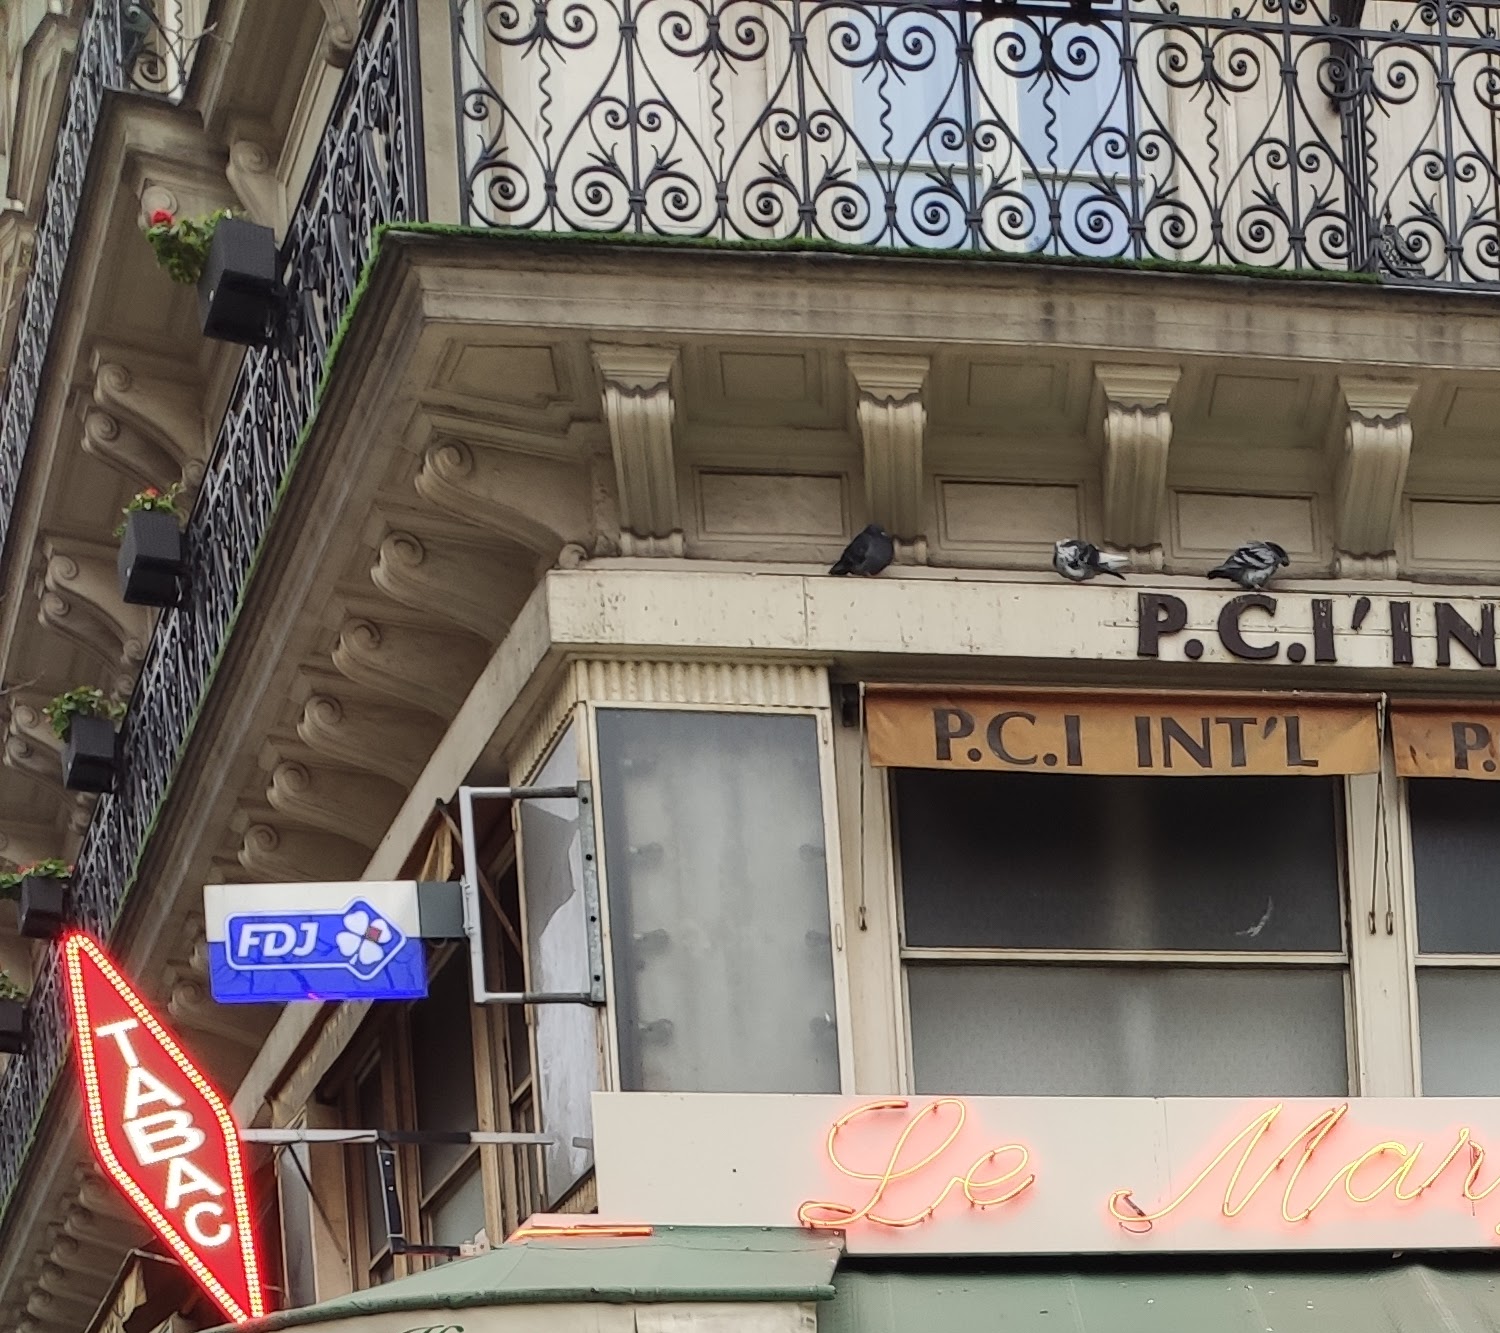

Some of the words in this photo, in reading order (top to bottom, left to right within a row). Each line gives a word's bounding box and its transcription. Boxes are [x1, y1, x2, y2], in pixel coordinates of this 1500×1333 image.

[933, 707, 1083, 767] P.C.I
[1136, 715, 1319, 768] INT'L
[237, 922, 318, 958] FDJ
[95, 1018, 232, 1248] TABAC
[800, 1098, 1037, 1228] Le
